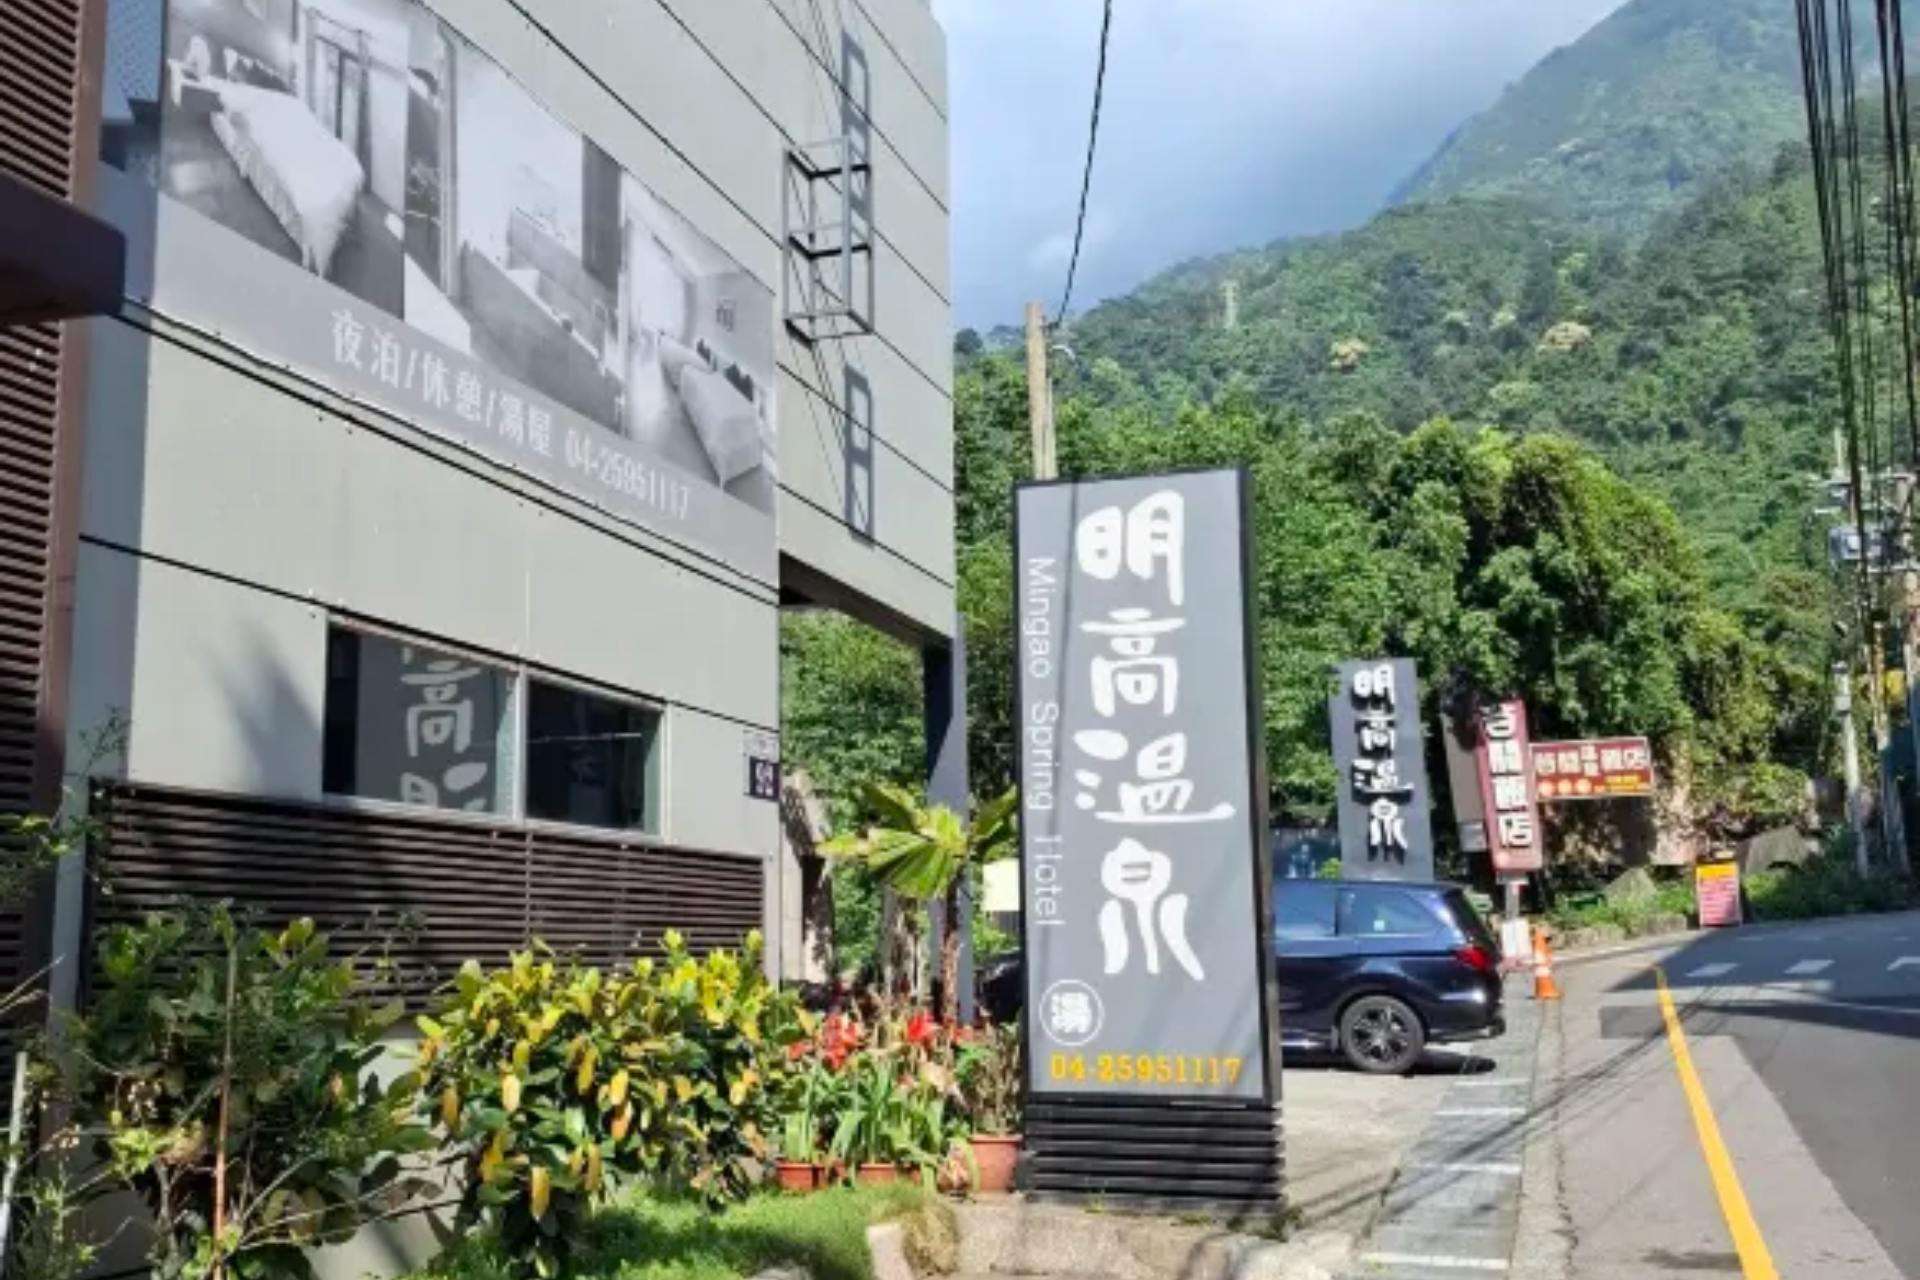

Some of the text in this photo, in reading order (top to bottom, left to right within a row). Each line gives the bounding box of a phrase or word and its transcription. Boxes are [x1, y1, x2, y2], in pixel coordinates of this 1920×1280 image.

[1022, 557, 1057, 679] Mingao
[1028, 700, 1061, 812] Spring
[1051, 1053, 1243, 1085] 04-25951117
